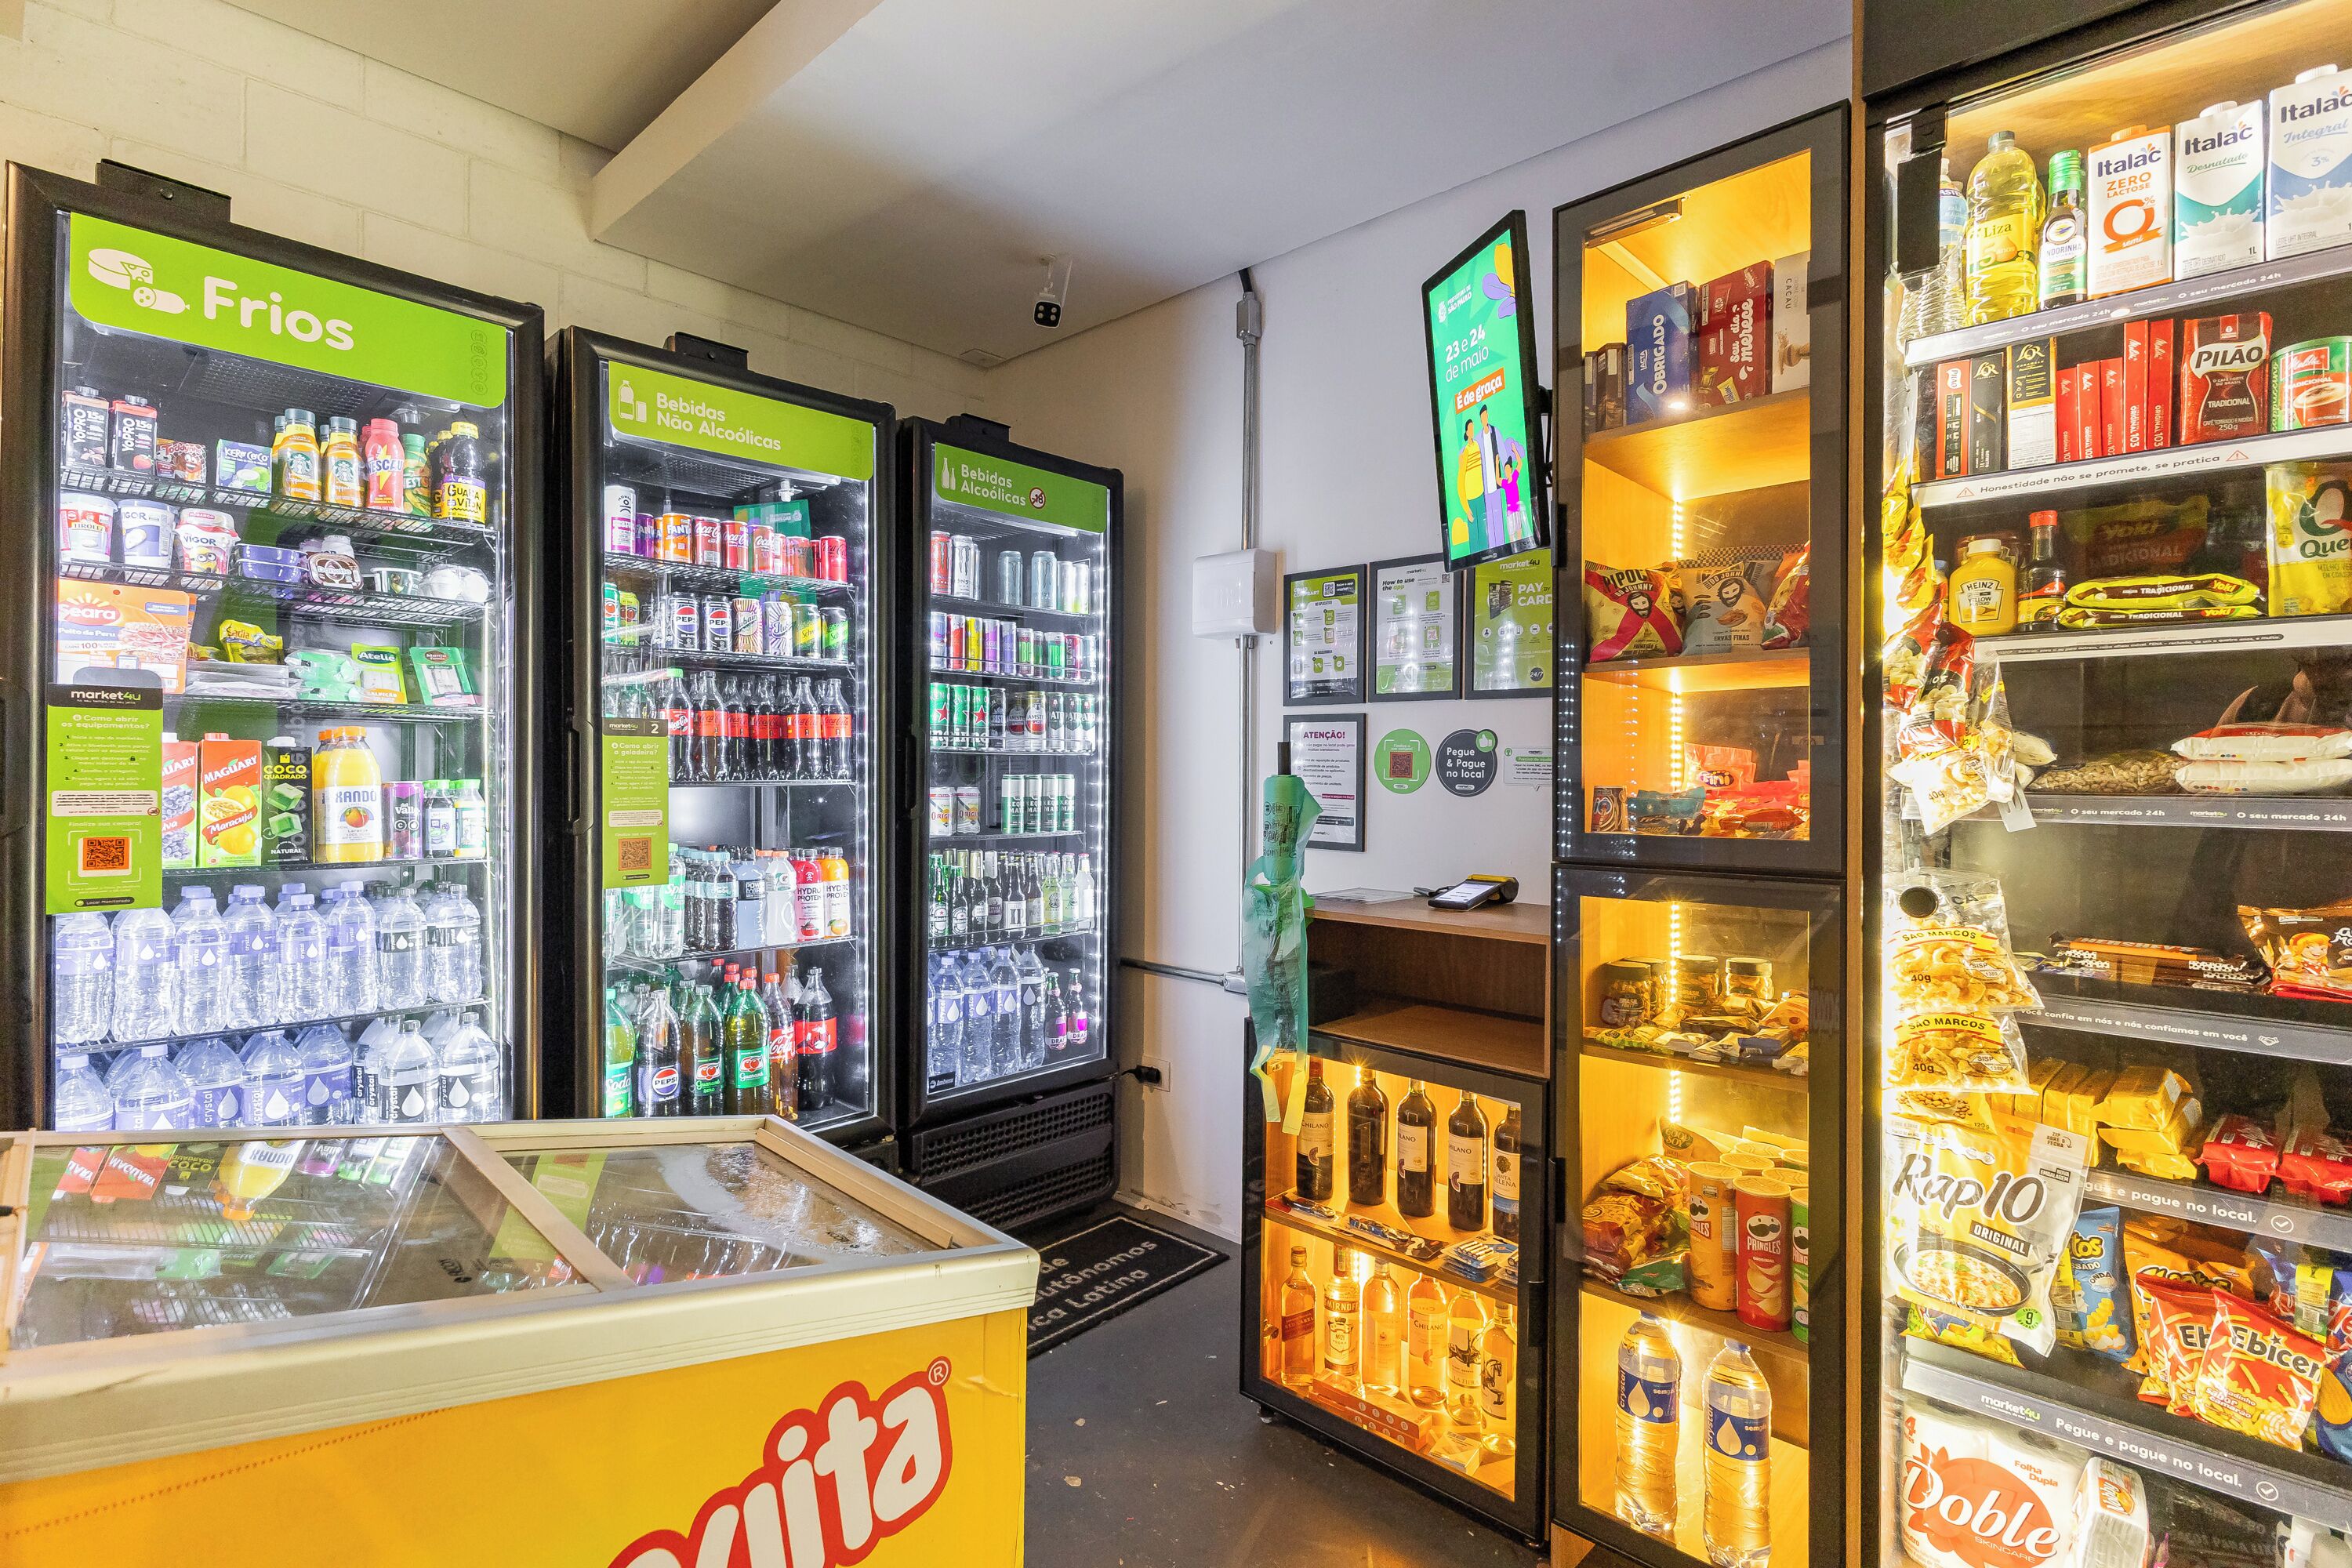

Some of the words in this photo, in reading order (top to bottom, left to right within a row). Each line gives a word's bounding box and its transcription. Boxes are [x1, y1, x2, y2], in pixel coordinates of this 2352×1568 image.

[2281, 93, 2352, 123] Italac
[2283, 118, 2348, 144] Integral
[2185, 126, 2254, 155] Italac
[2098, 147, 2161, 177] Italac
[2187, 152, 2249, 174] Desnatado
[2107, 172, 2152, 192] ZERO
[2107, 182, 2151, 199] LACTOSE
[1984, 223, 2013, 238] Liza
[2122, 234, 2144, 249] semi
[2210, 278, 2256, 292] mercado
[2259, 273, 2281, 281] 24h
[1447, 301, 1457, 314] SÃO
[1458, 293, 1472, 310] PAULO
[204, 276, 354, 350] Frios
[2049, 315, 2089, 327] mercado
[1741, 298, 1753, 362] merece
[1446, 342, 1460, 363] 23
[1461, 338, 1469, 350] e
[1469, 325, 1486, 348] 24
[1730, 341, 1740, 363] Seu
[1653, 314, 1668, 395] OBRIGADO
[2195, 344, 2263, 368] PILÃO
[1446, 361, 1459, 383] de
[1461, 347, 1489, 374] maio
[1463, 385, 1475, 406] de
[1475, 372, 1502, 398] graça
[656, 392, 726, 423] Bebidas
[2208, 397, 2251, 408] TRADICIONAL
[657, 408, 693, 433] Não
[699, 420, 782, 451] Alcoólicas
[2130, 434, 2140, 448] 103
[2154, 434, 2163, 448] 103
[961, 463, 1012, 488] Bebidas
[1980, 477, 2049, 493] Honestidade
[2053, 474, 2075, 482] não
[2096, 463, 2151, 479] promete,
[2173, 456, 2220, 468] pratica
[960, 480, 1026, 506] Alcoólicas
[73, 522, 103, 532] TIROLEZ
[183, 535, 216, 546] VIGOR
[1500, 558, 1540, 571] market4u
[1404, 575, 1415, 583] use
[1966, 581, 1994, 591] HEINZ
[2140, 583, 2194, 594] TRADICIONAL
[2212, 579, 2237, 593] Yoki
[1518, 582, 1544, 593] PAY
[1625, 583, 1653, 593] JOHNNY
[2129, 611, 2183, 619] TRADICIONAL
[2205, 608, 2232, 616] Yoki
[71, 689, 142, 702] market4u
[76, 721, 151, 730] equipamentos?
[115, 714, 139, 723] abrir
[609, 722, 639, 731] market4u
[651, 723, 659, 734] 2
[1304, 730, 1345, 742] ATENÇÃO!
[1447, 747, 1475, 758] Pegue
[204, 754, 257, 785] MAGUARY
[263, 764, 307, 775] COCO
[1446, 759, 1454, 768] &
[1457, 758, 1486, 770] Pague
[1461, 769, 1484, 779] local
[2100, 808, 2143, 818] mercado
[2237, 811, 2247, 820] O
[2270, 813, 2321, 822] mercado
[2323, 814, 2347, 822] 24h
[208, 811, 253, 835] Maracujá
[270, 847, 302, 855] NATURAL
[1928, 929, 1977, 940] MARCOS
[1911, 974, 1932, 983] 40g
[1934, 1018, 1986, 1031] MARCOS
[2045, 1011, 2074, 1022] confia
[2095, 1015, 2112, 1025] nós
[2124, 1018, 2142, 1029] nós
[2145, 1022, 2201, 1036] confiamos
[2223, 1030, 2249, 1043] você
[1913, 1063, 1934, 1074] 40g
[655, 1076, 678, 1087] PEPSI
[205, 1090, 213, 1123] crystal
[2040, 1171, 2070, 1182] EMBALAGEM
[1893, 1153, 2044, 1223] Rap10
[2131, 1190, 2181, 1208] pague
[2187, 1200, 2207, 1213] no
[2212, 1204, 2257, 1224] local.
[1747, 1239, 1781, 1255] PRINGLES
[1973, 1224, 2027, 1254] ORIGINAL
[1065, 1269, 1149, 1308] Latina
[1414, 1319, 1444, 1331] CHILANO
[2025, 1311, 2034, 1326] 9
[2206, 1387, 2240, 1406] sabor
[1980, 1394, 2042, 1421] market4u
[1904, 1416, 1917, 1437] 4
[2055, 1417, 2100, 1443] Pegue
[2104, 1435, 2114, 1446] e
[2118, 1439, 2168, 1465] pague
[2172, 1456, 2194, 1472] no
[2198, 1462, 2243, 1488] local.
[2014, 1459, 2043, 1475] Folha
[2028, 1472, 2060, 1488] Dupla
[1902, 1455, 2061, 1559] Doble
[1973, 1535, 2038, 1565] SKINCARE
